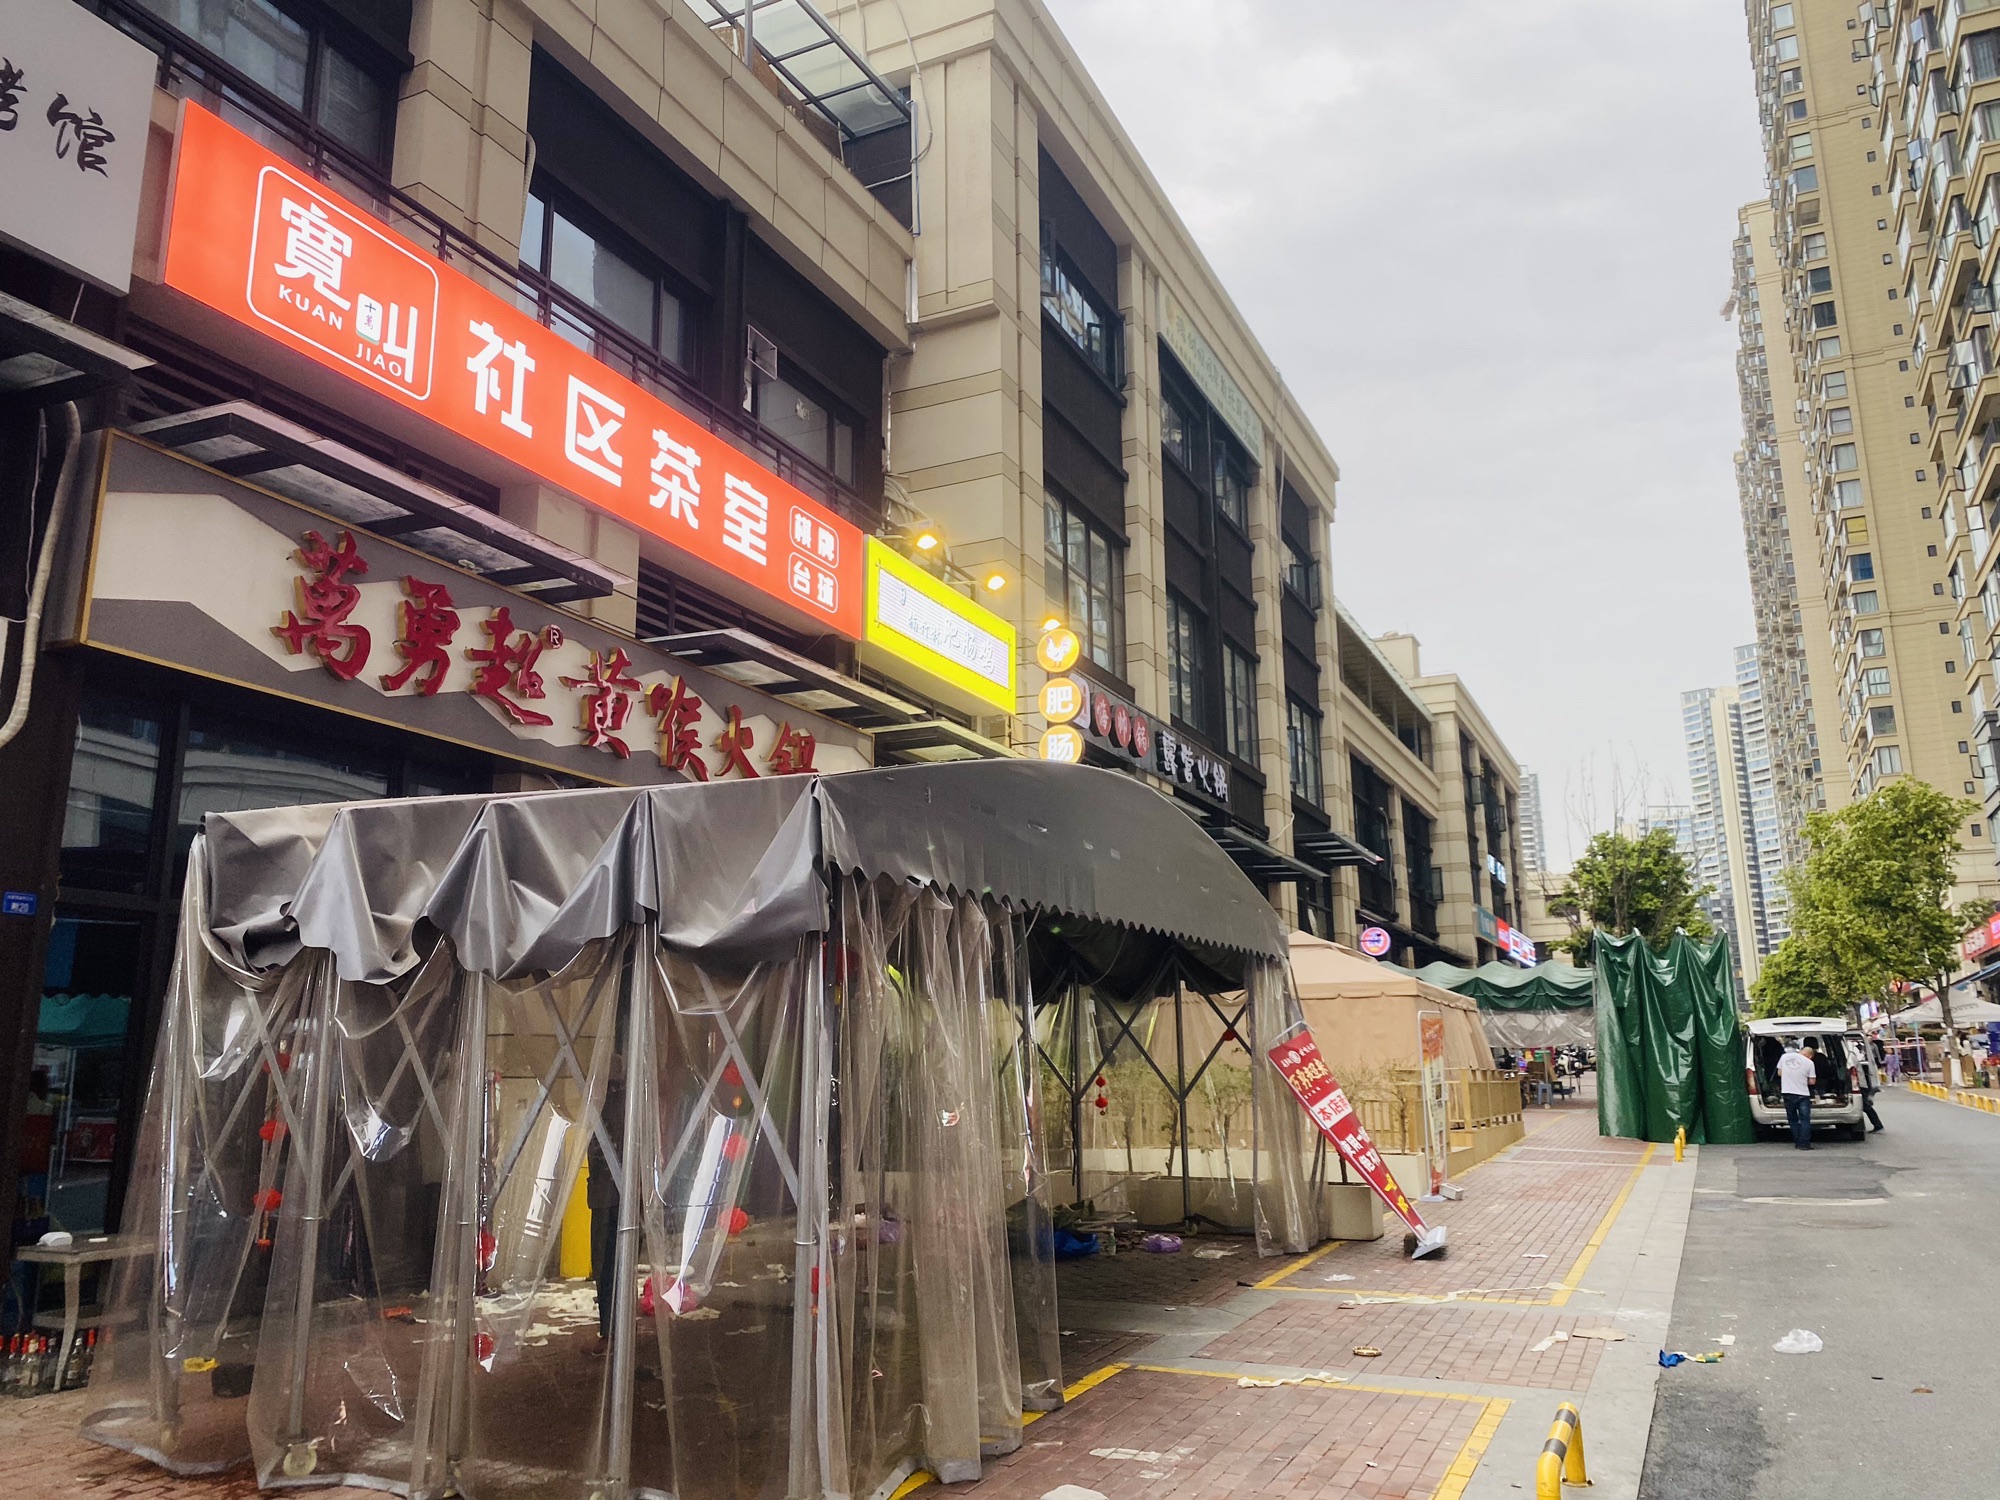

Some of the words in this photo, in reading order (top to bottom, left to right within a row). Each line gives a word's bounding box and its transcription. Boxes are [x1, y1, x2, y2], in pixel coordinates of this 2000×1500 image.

[278, 283, 343, 331] KUAN
[356, 343, 403, 377] JIAO
[466, 319, 769, 566] 社区茶室
[794, 513, 835, 561] 棋牌
[793, 560, 834, 608] 台球
[1046, 686, 1074, 761] 肥肠
[1161, 730, 1229, 803] 露营火锅
